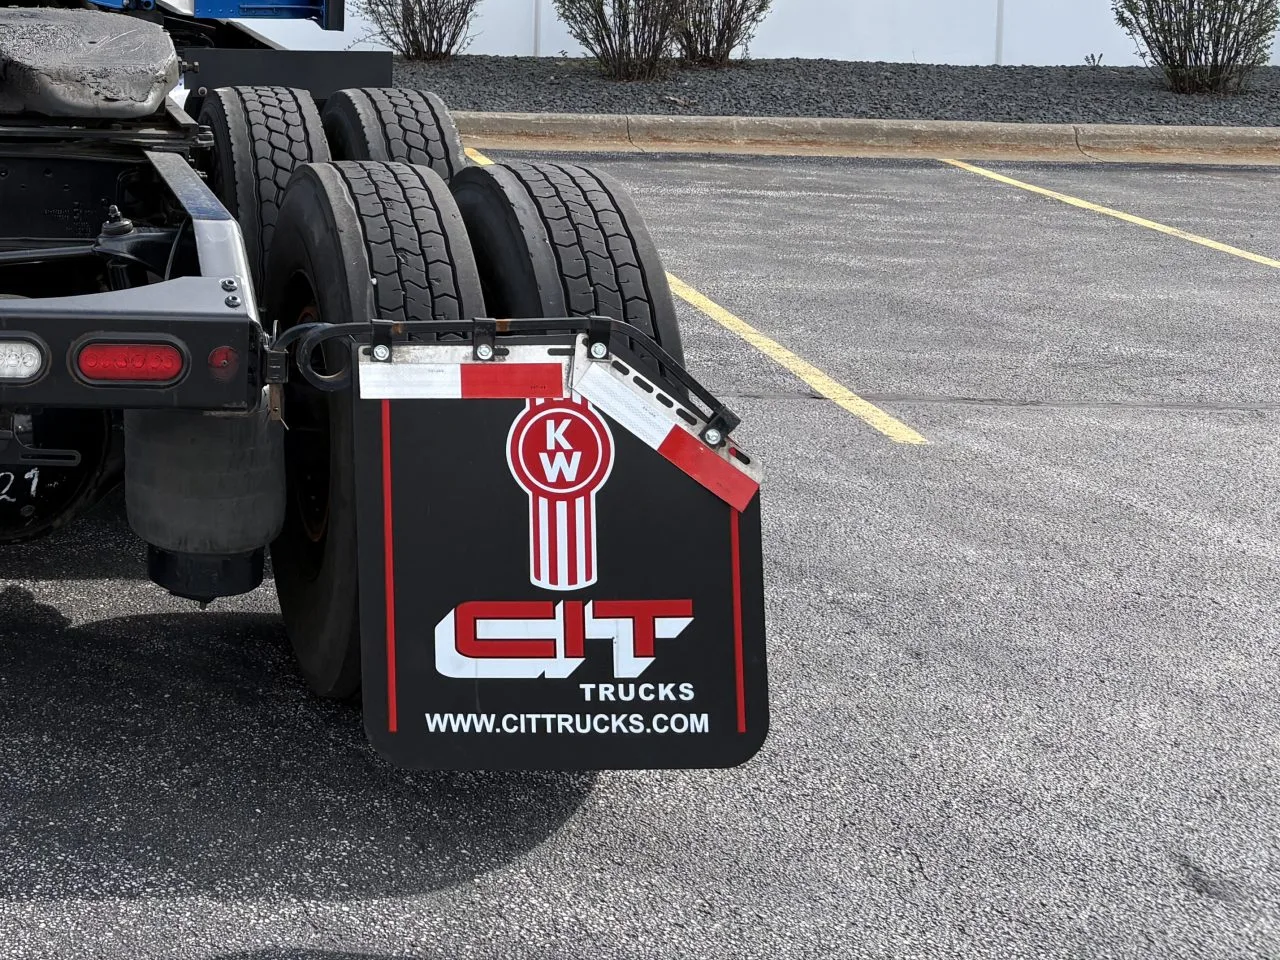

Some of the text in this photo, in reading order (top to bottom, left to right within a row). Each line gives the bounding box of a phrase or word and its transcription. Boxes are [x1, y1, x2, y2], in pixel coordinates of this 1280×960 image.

[435, 599, 695, 678] CIT
[580, 683, 695, 701] TRUCKS
[425, 713, 709, 733] WWW.CITTRUCKS.COM
